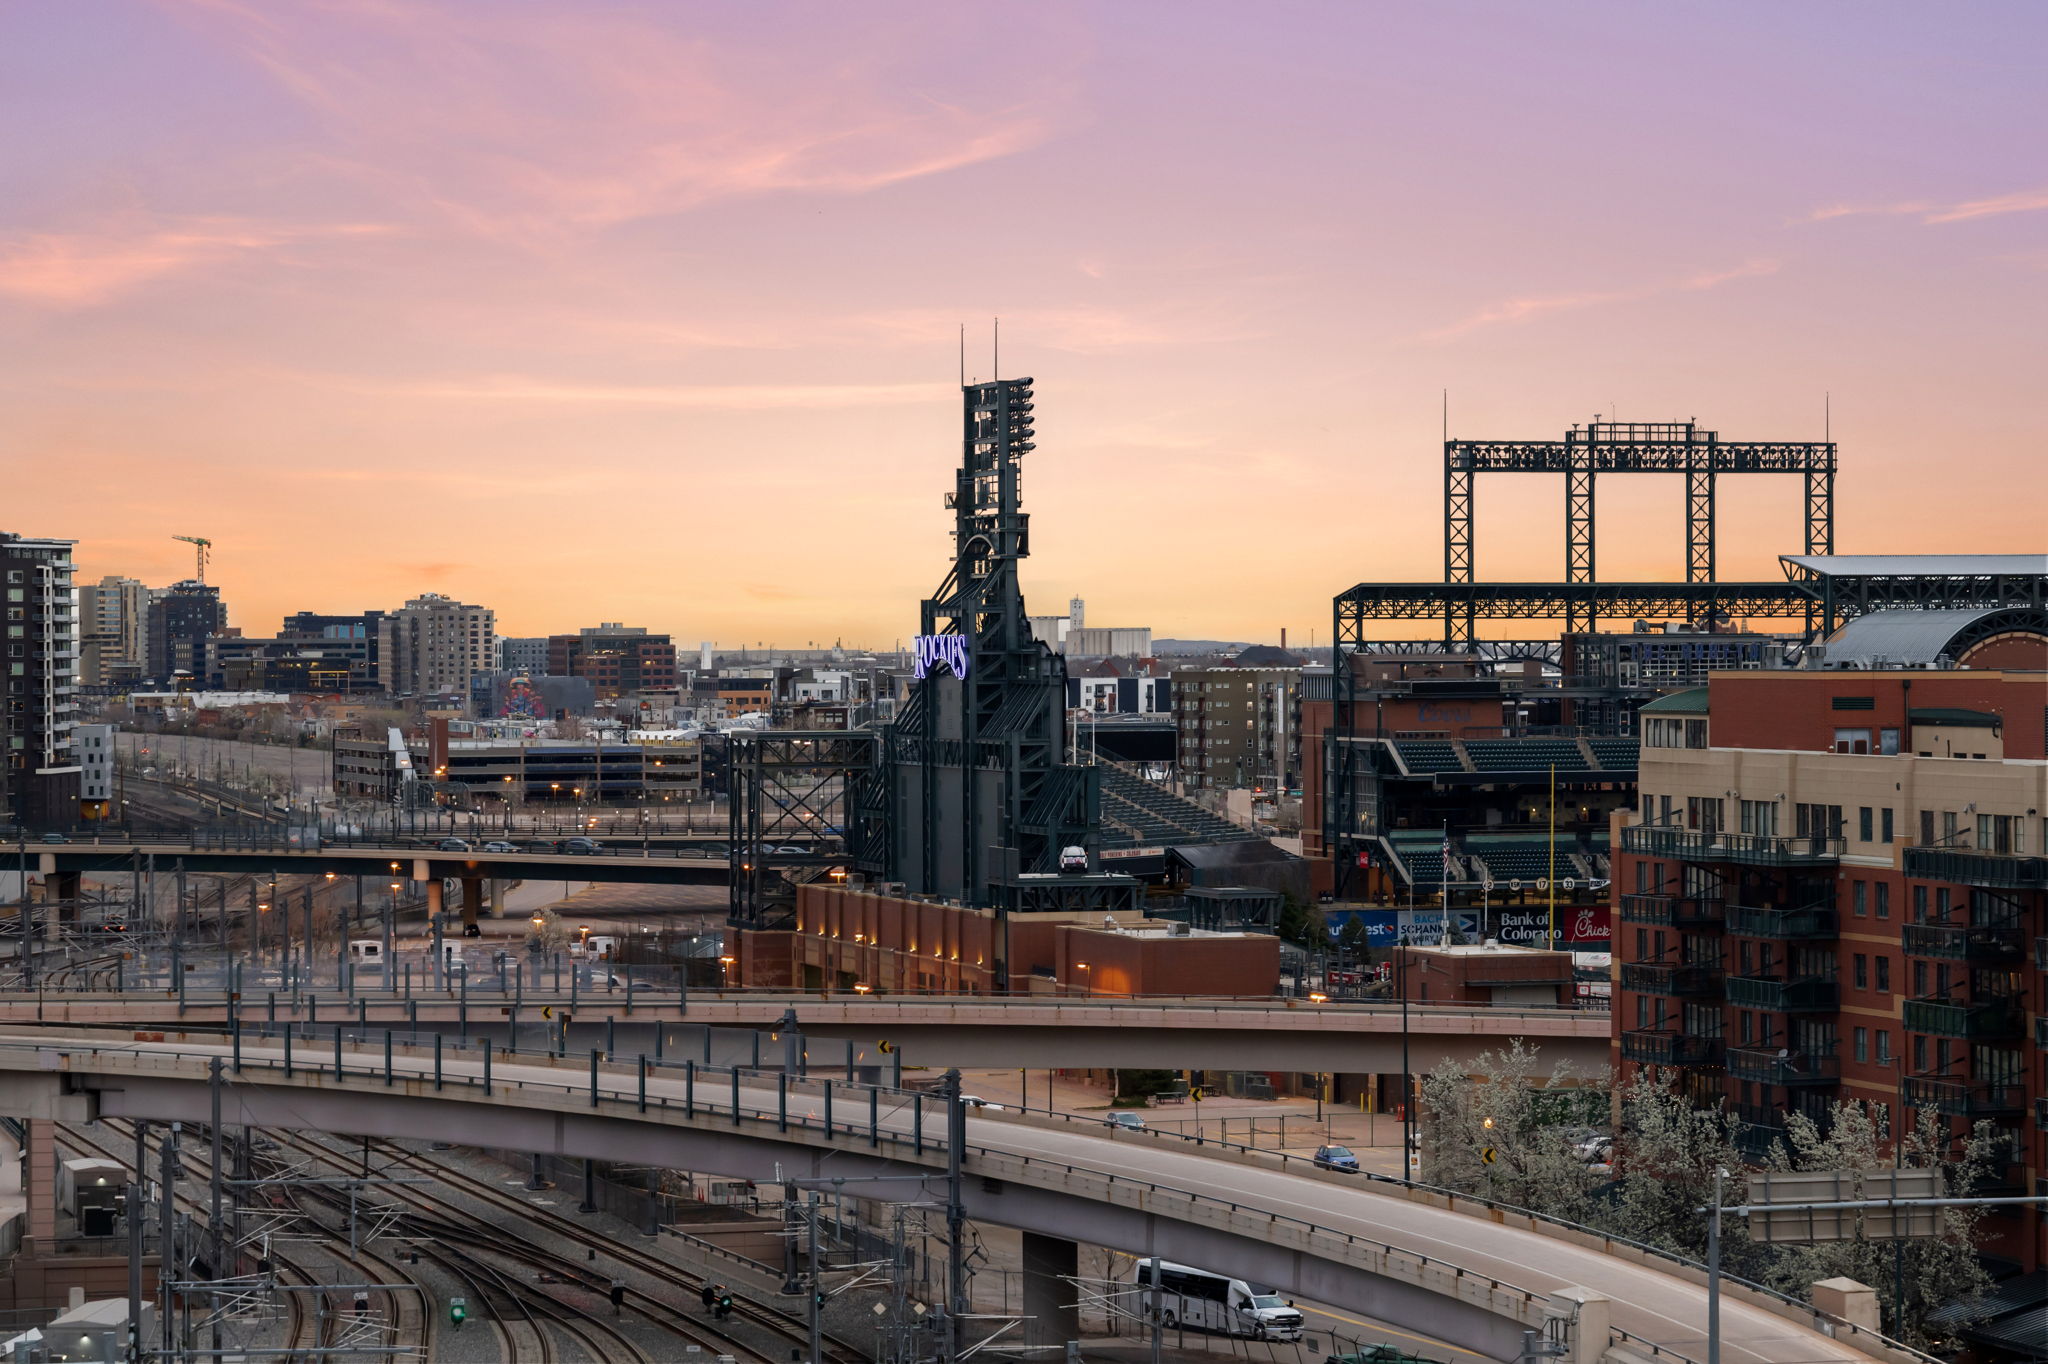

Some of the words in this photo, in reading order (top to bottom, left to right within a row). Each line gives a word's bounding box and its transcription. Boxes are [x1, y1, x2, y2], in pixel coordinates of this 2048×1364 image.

[913, 633, 967, 681] ROCKIES
[1681, 643, 1760, 661] ROOFTO
[1501, 911, 1534, 926] Bank
[1536, 911, 1550, 926] of
[1400, 924, 1445, 934] SCHANK
